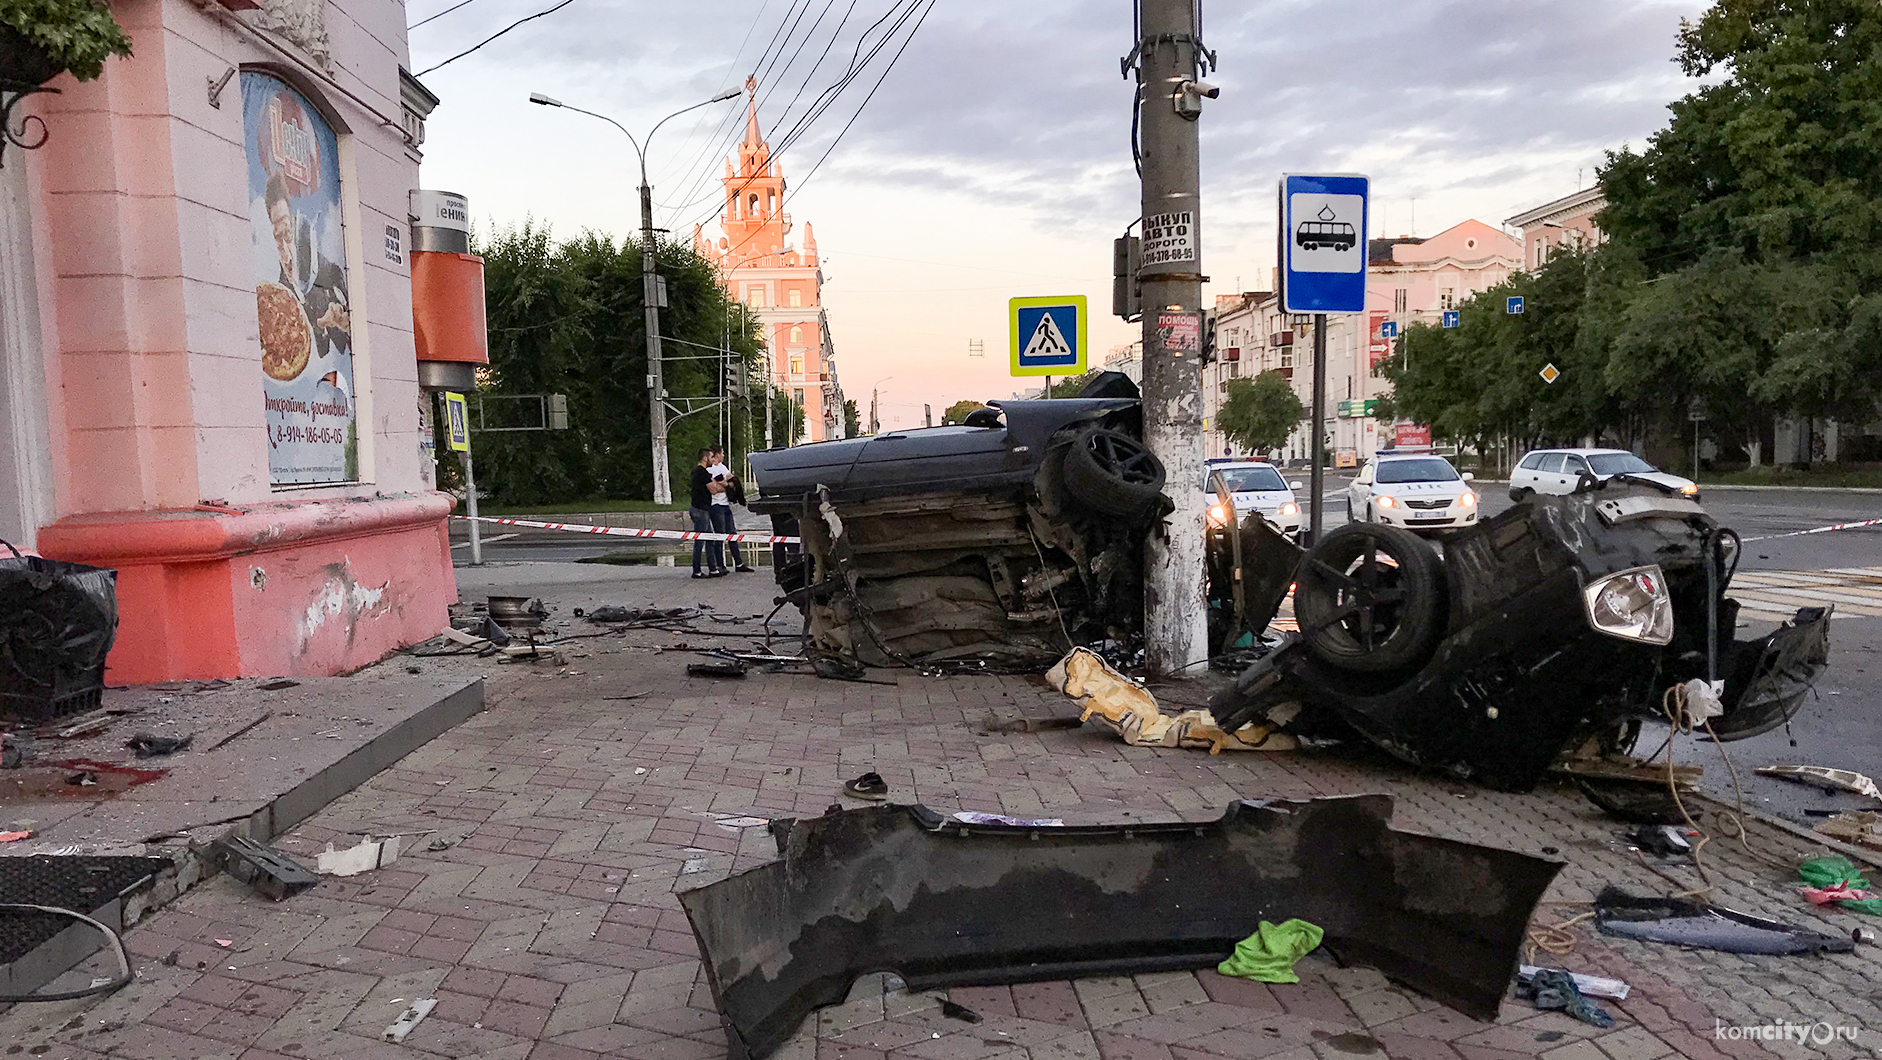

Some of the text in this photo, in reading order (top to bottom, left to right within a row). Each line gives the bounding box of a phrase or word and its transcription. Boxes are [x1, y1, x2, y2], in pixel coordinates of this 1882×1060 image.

[1142, 212, 1191, 231] ВЫКУП
[1144, 225, 1187, 242] АВТО
[1143, 238, 1187, 253] ДОРОГО
[1158, 315, 1199, 326] ПОМОЩЬ
[277, 425, 343, 444] 8-914-186-05-05
